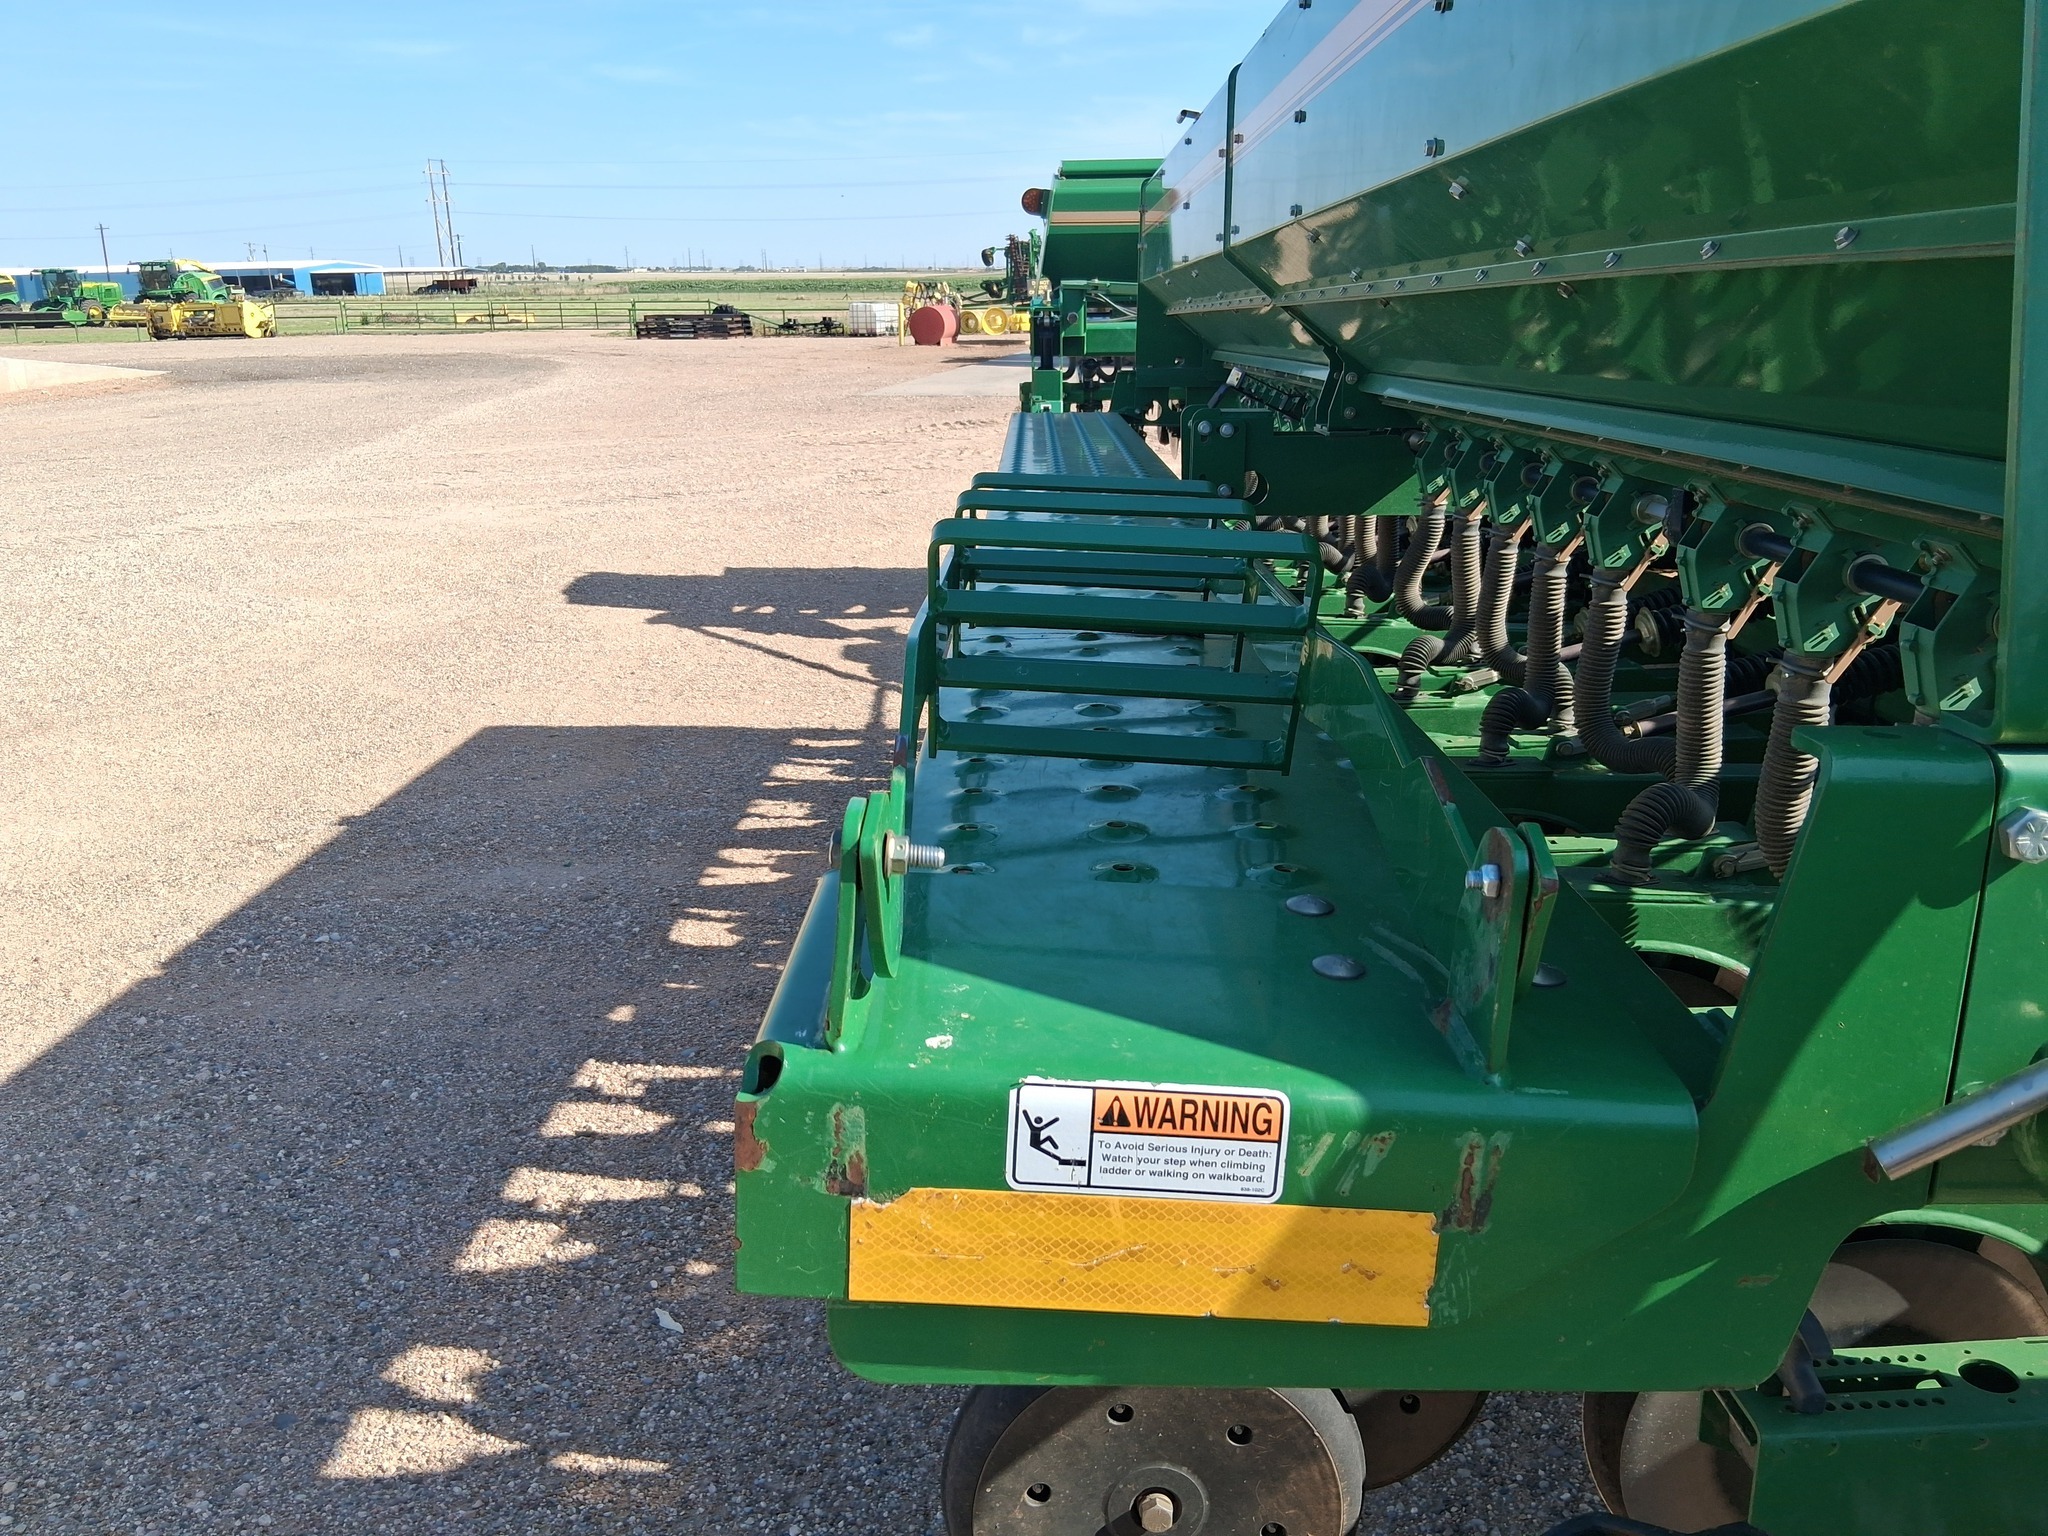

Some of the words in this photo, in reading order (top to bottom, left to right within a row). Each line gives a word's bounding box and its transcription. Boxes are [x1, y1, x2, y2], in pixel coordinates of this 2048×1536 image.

[1134, 1095, 1273, 1136] WARNING
[1098, 1140, 1111, 1149] To
[1114, 1142, 1144, 1151] Avoid
[1148, 1143, 1188, 1153] Serious
[1191, 1146, 1221, 1157] Injury
[1238, 1148, 1272, 1158] Death:
[1102, 1154, 1133, 1163] Watch
[1137, 1157, 1160, 1166] your
[1164, 1158, 1186, 1167] step
[1189, 1159, 1217, 1168] when
[1220, 1160, 1265, 1172] climbing
[1099, 1166, 1132, 1175] ladder
[1149, 1170, 1189, 1180] walking
[1208, 1173, 1265, 1183] walkboard.
